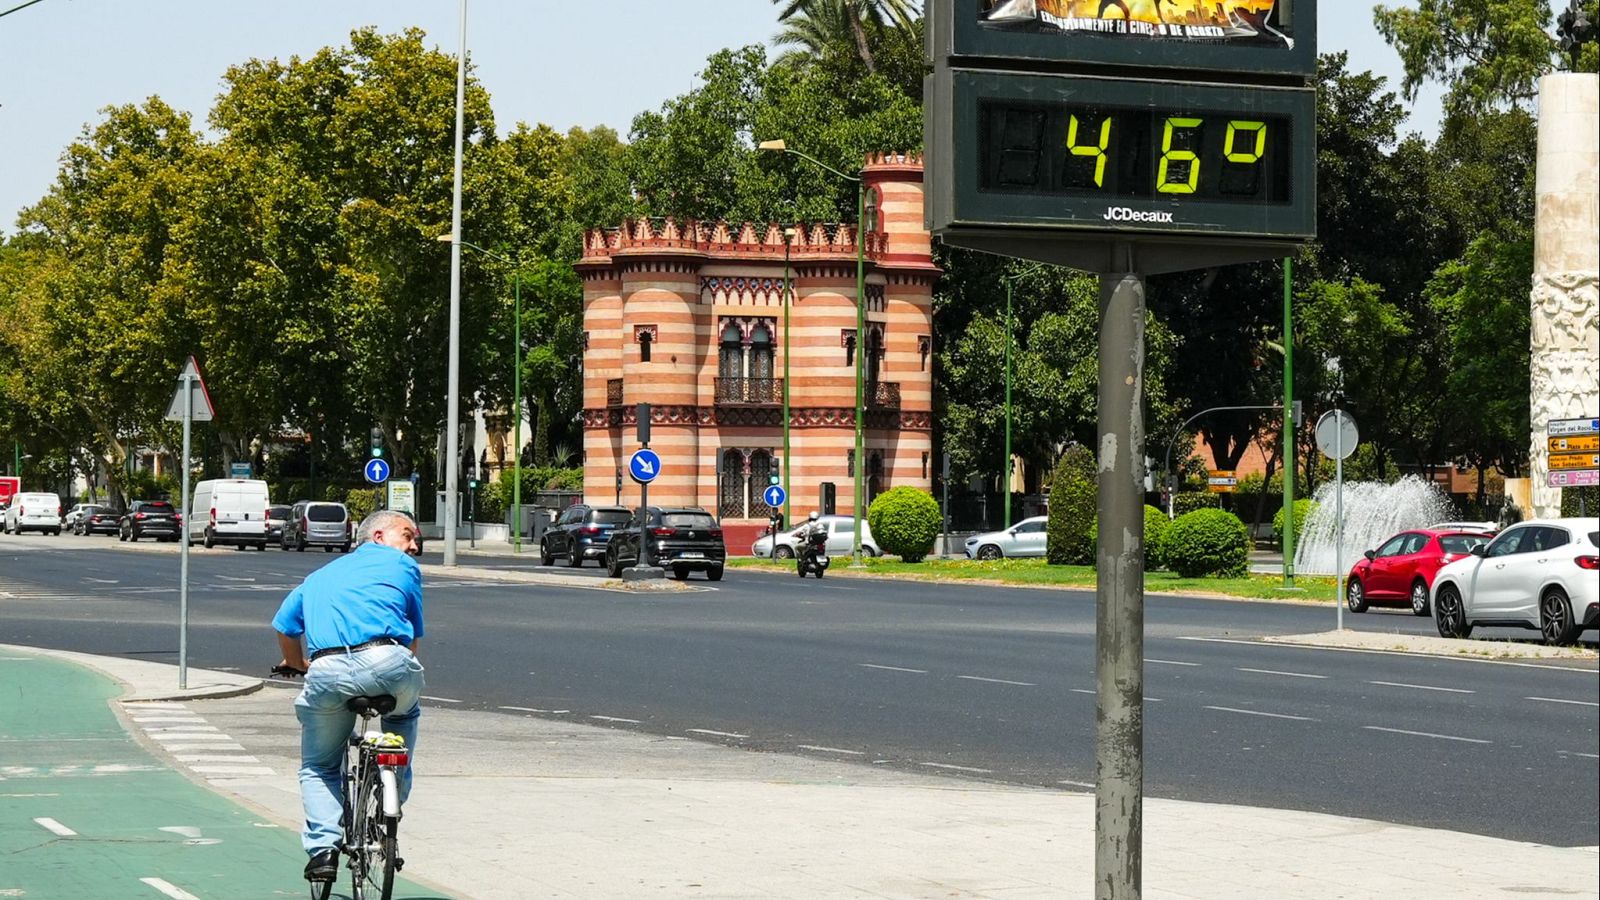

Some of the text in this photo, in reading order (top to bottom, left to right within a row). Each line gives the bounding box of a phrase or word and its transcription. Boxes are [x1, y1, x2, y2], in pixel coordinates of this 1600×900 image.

[1116, 19, 1127, 34] EN
[1169, 24, 1183, 36] DE
[1185, 25, 1225, 37] AGOSTO
[1103, 207, 1173, 224] JCDecaux
